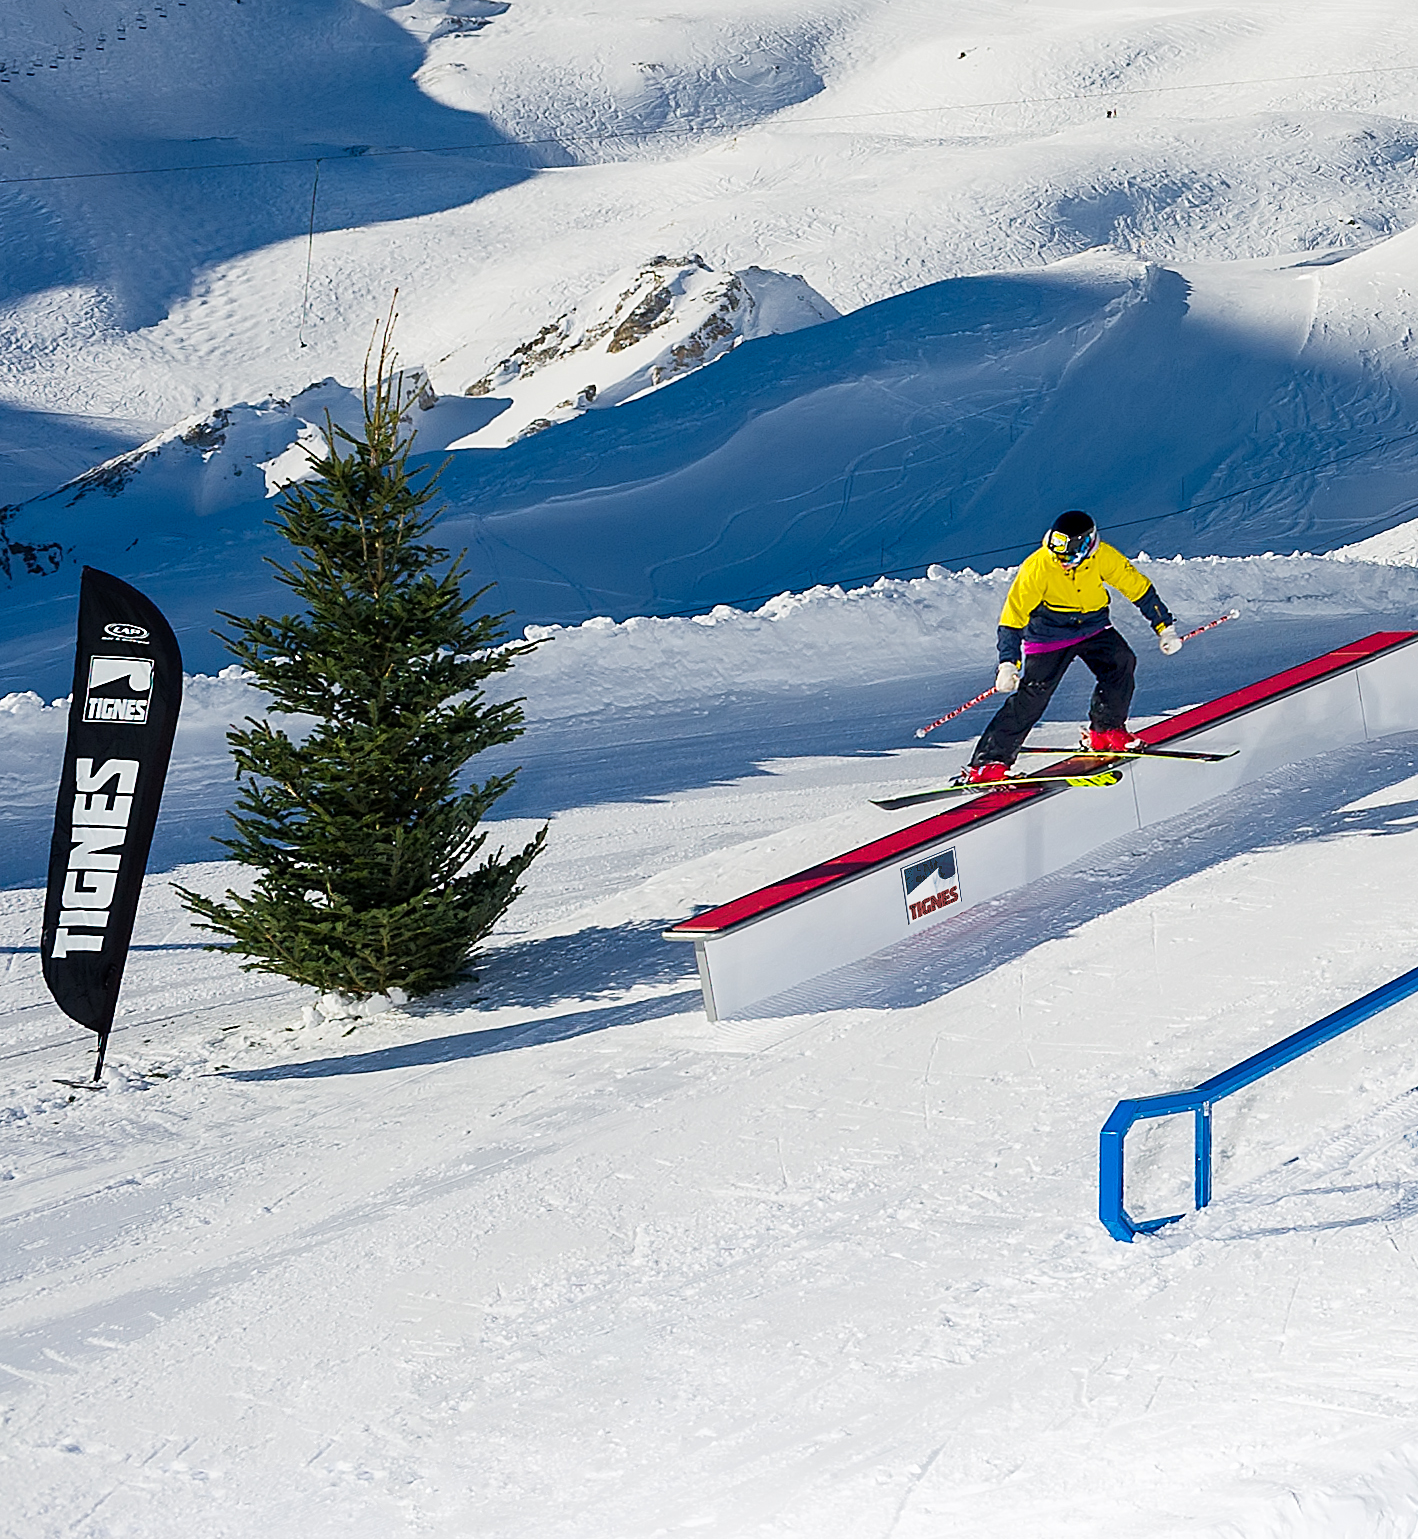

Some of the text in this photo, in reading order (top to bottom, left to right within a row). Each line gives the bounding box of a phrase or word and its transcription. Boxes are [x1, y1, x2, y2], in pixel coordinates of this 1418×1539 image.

[88, 697, 148, 721] TIGNES
[52, 757, 140, 958] TIGNES
[909, 885, 959, 920] TIGNES
